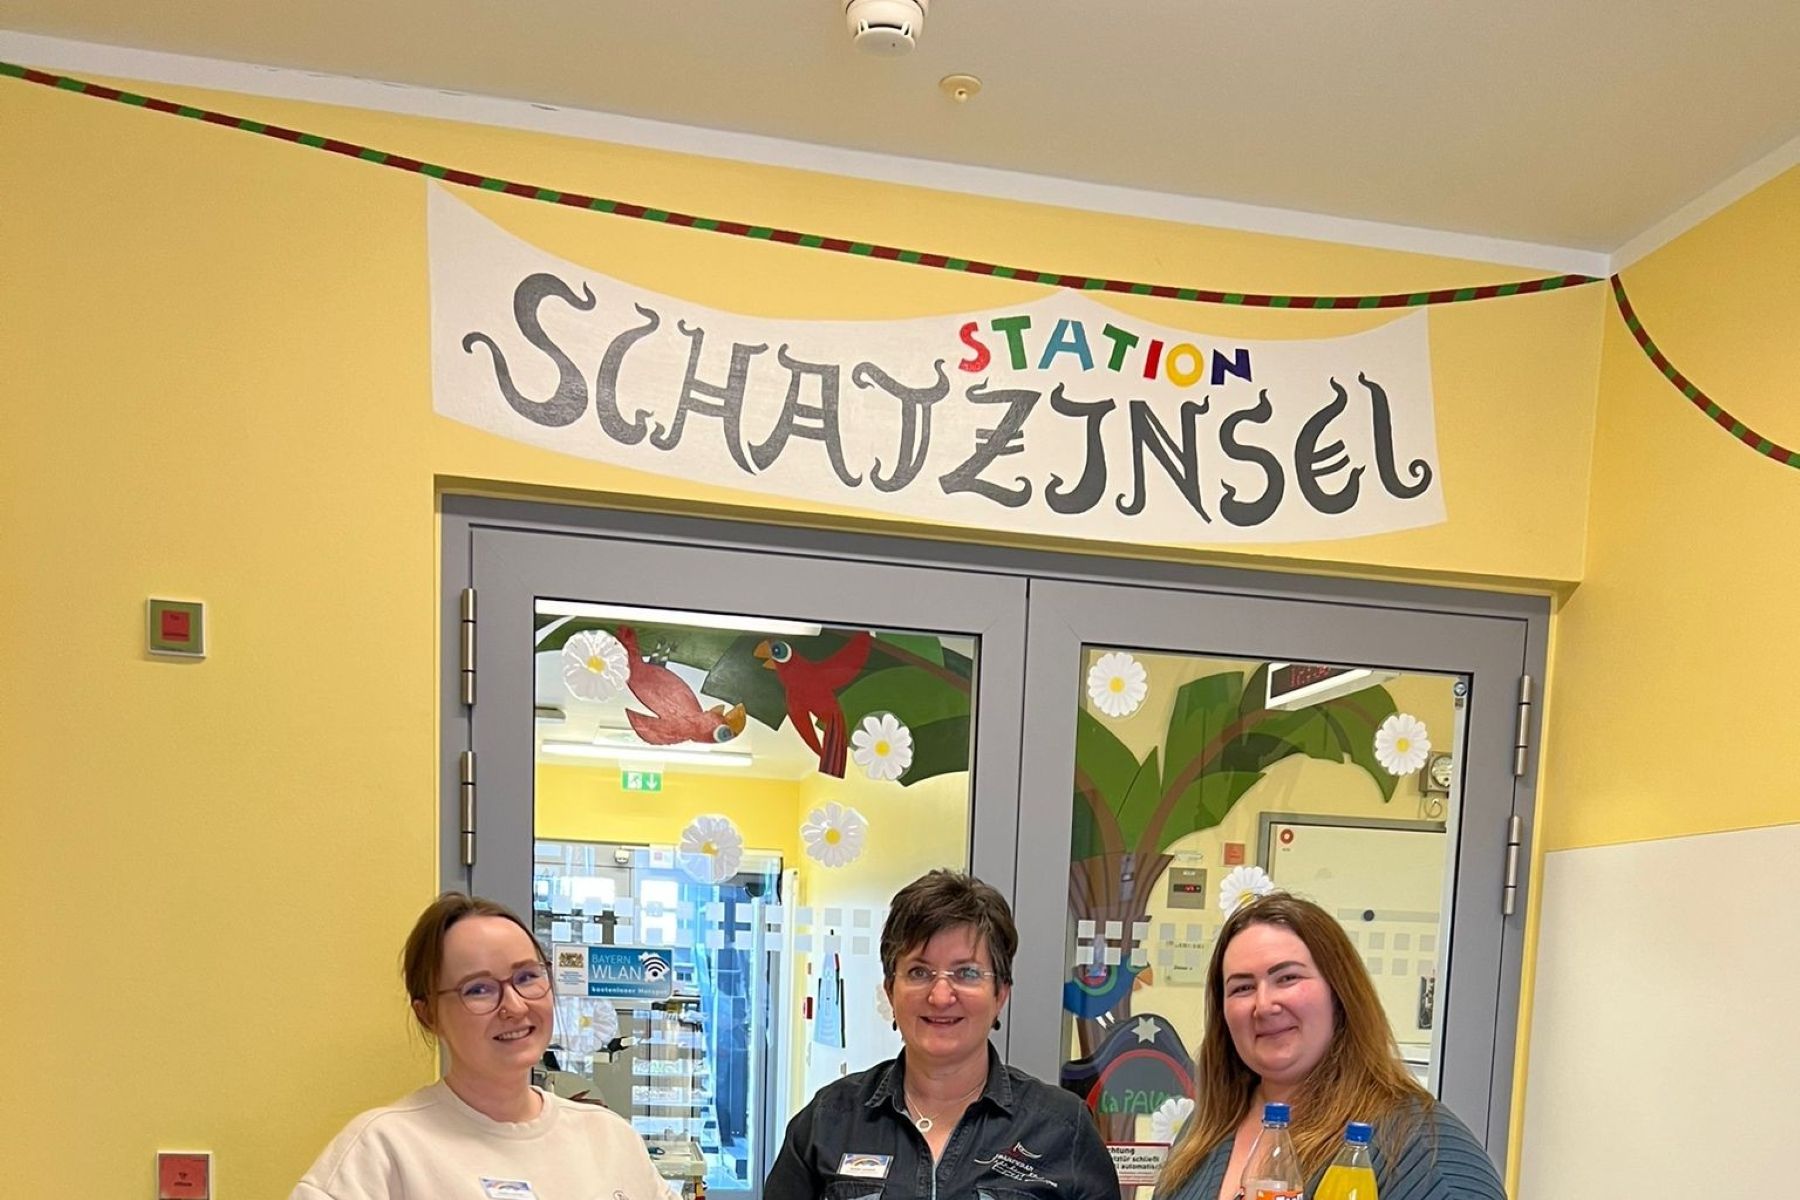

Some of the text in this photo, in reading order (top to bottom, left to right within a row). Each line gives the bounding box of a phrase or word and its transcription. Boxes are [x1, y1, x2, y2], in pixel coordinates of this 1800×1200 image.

[958, 316, 1253, 388] STATION
[591, 953, 631, 965] BAYERN
[592, 964, 642, 981] WLAN
